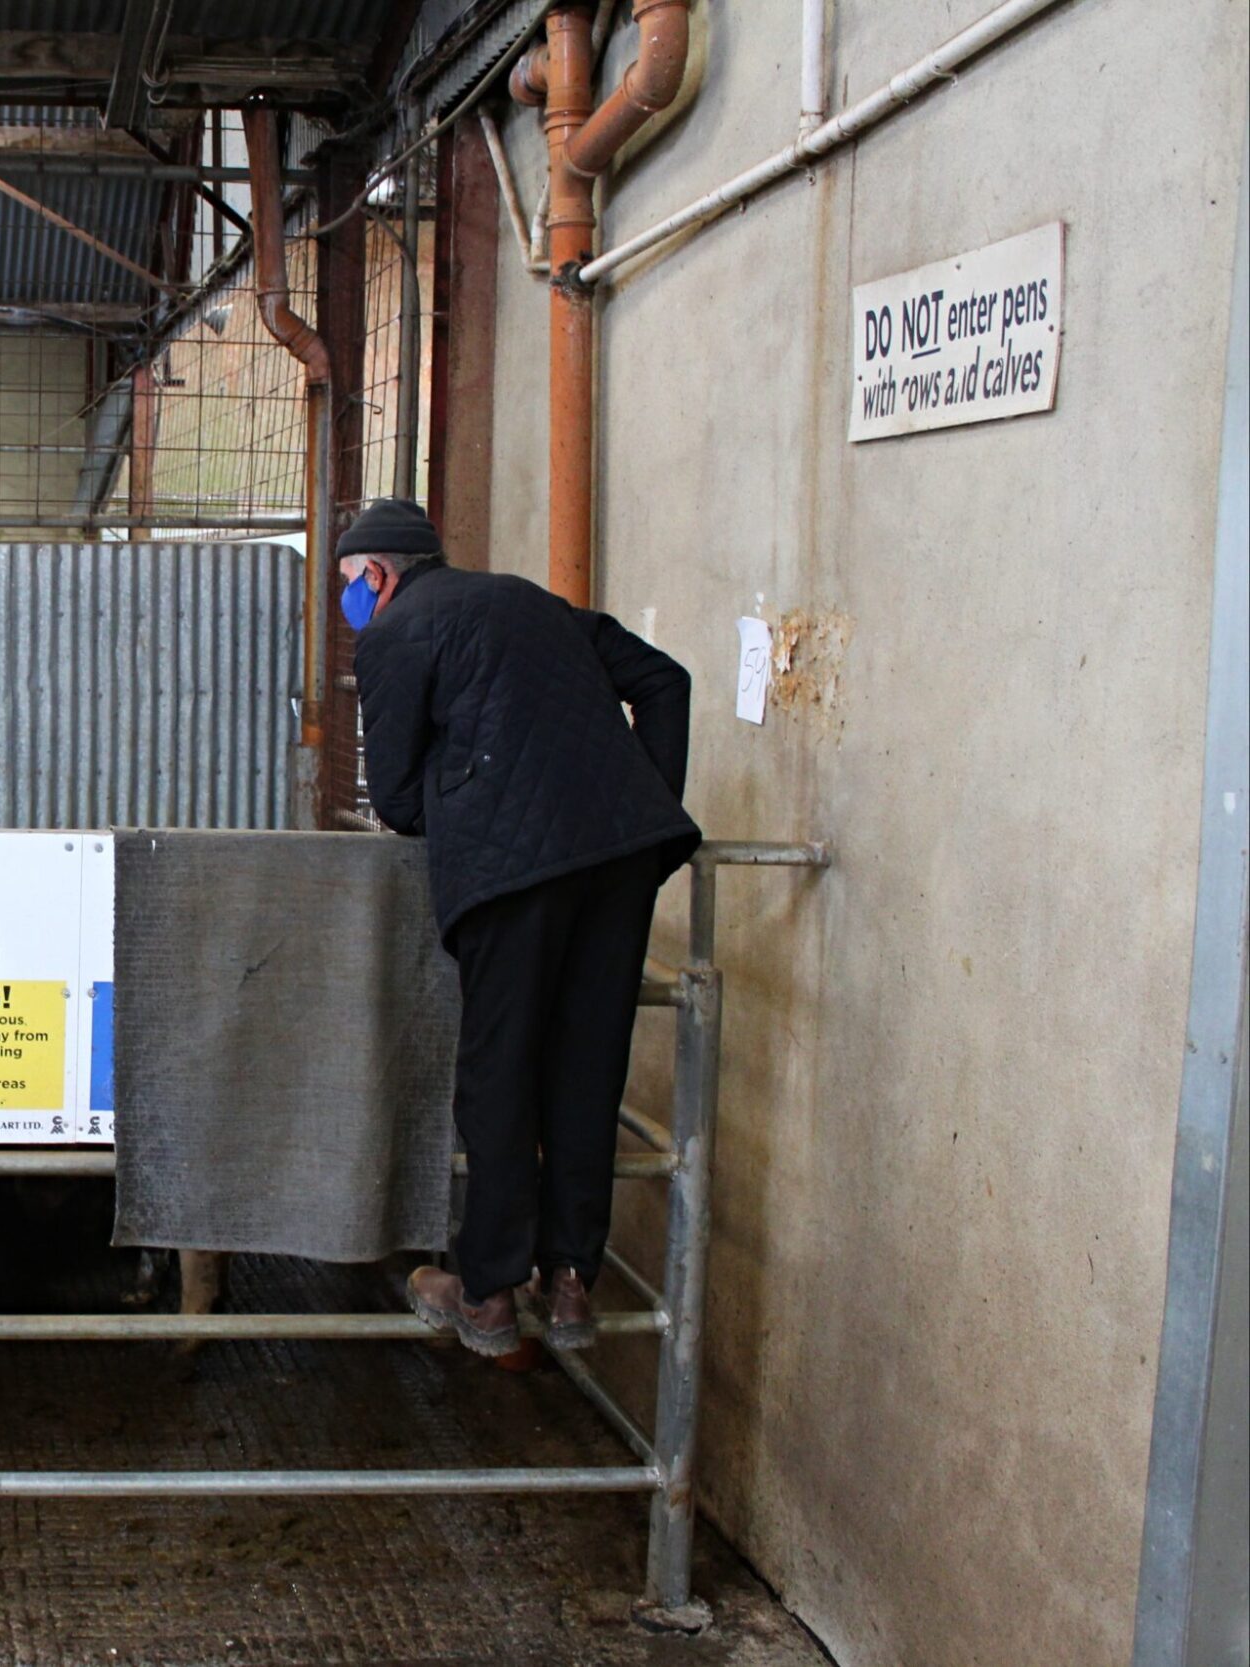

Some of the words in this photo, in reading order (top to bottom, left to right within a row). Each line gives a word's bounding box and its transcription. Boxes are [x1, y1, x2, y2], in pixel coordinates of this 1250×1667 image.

[865, 305, 892, 361] DO
[901, 289, 944, 355] NOT
[947, 288, 997, 341] enter
[1001, 278, 1048, 347] pens
[863, 364, 897, 421] with
[983, 338, 1043, 399] calves
[14, 1030, 49, 1042] from
[23, 1121, 44, 1130] LTD.
